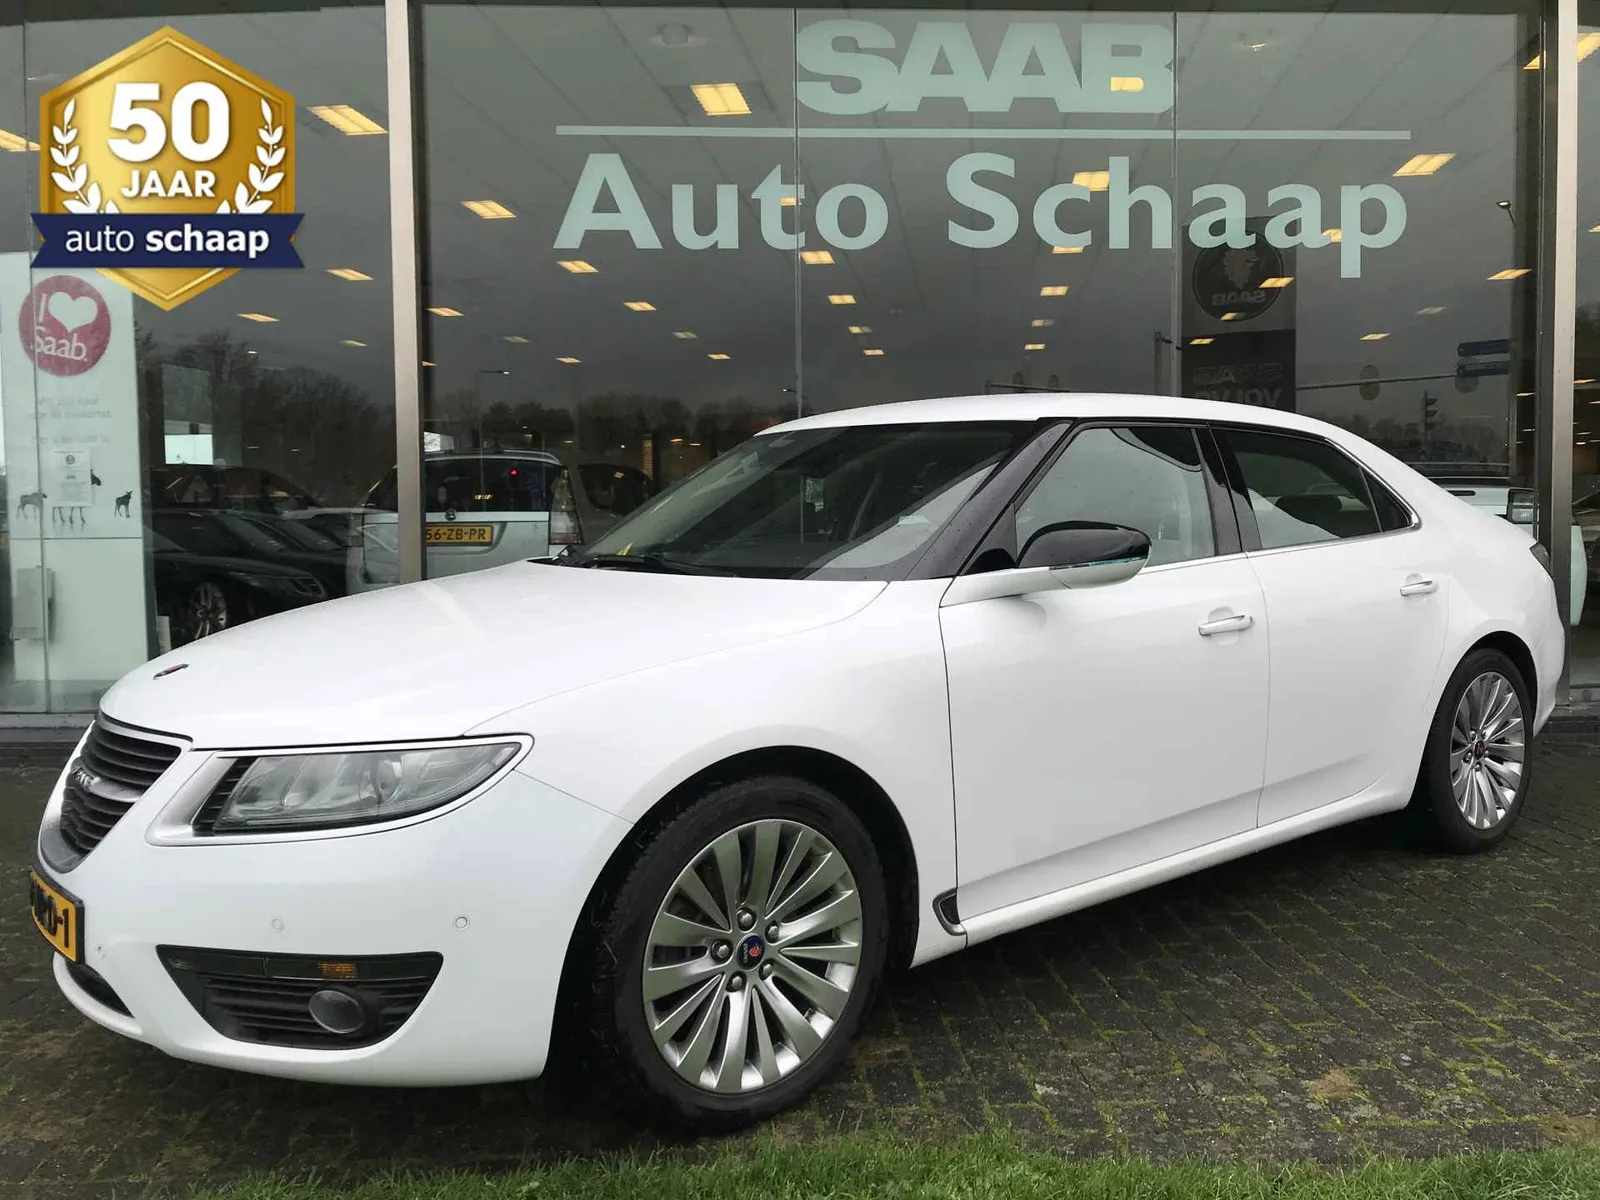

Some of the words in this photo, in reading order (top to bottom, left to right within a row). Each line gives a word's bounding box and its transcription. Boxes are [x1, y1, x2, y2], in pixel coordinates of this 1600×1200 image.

[797, 19, 1175, 115] SAAB
[553, 152, 889, 251] Auto
[946, 151, 1408, 279] Schaap
[426, 528, 486, 541] 56-ZB-PR
